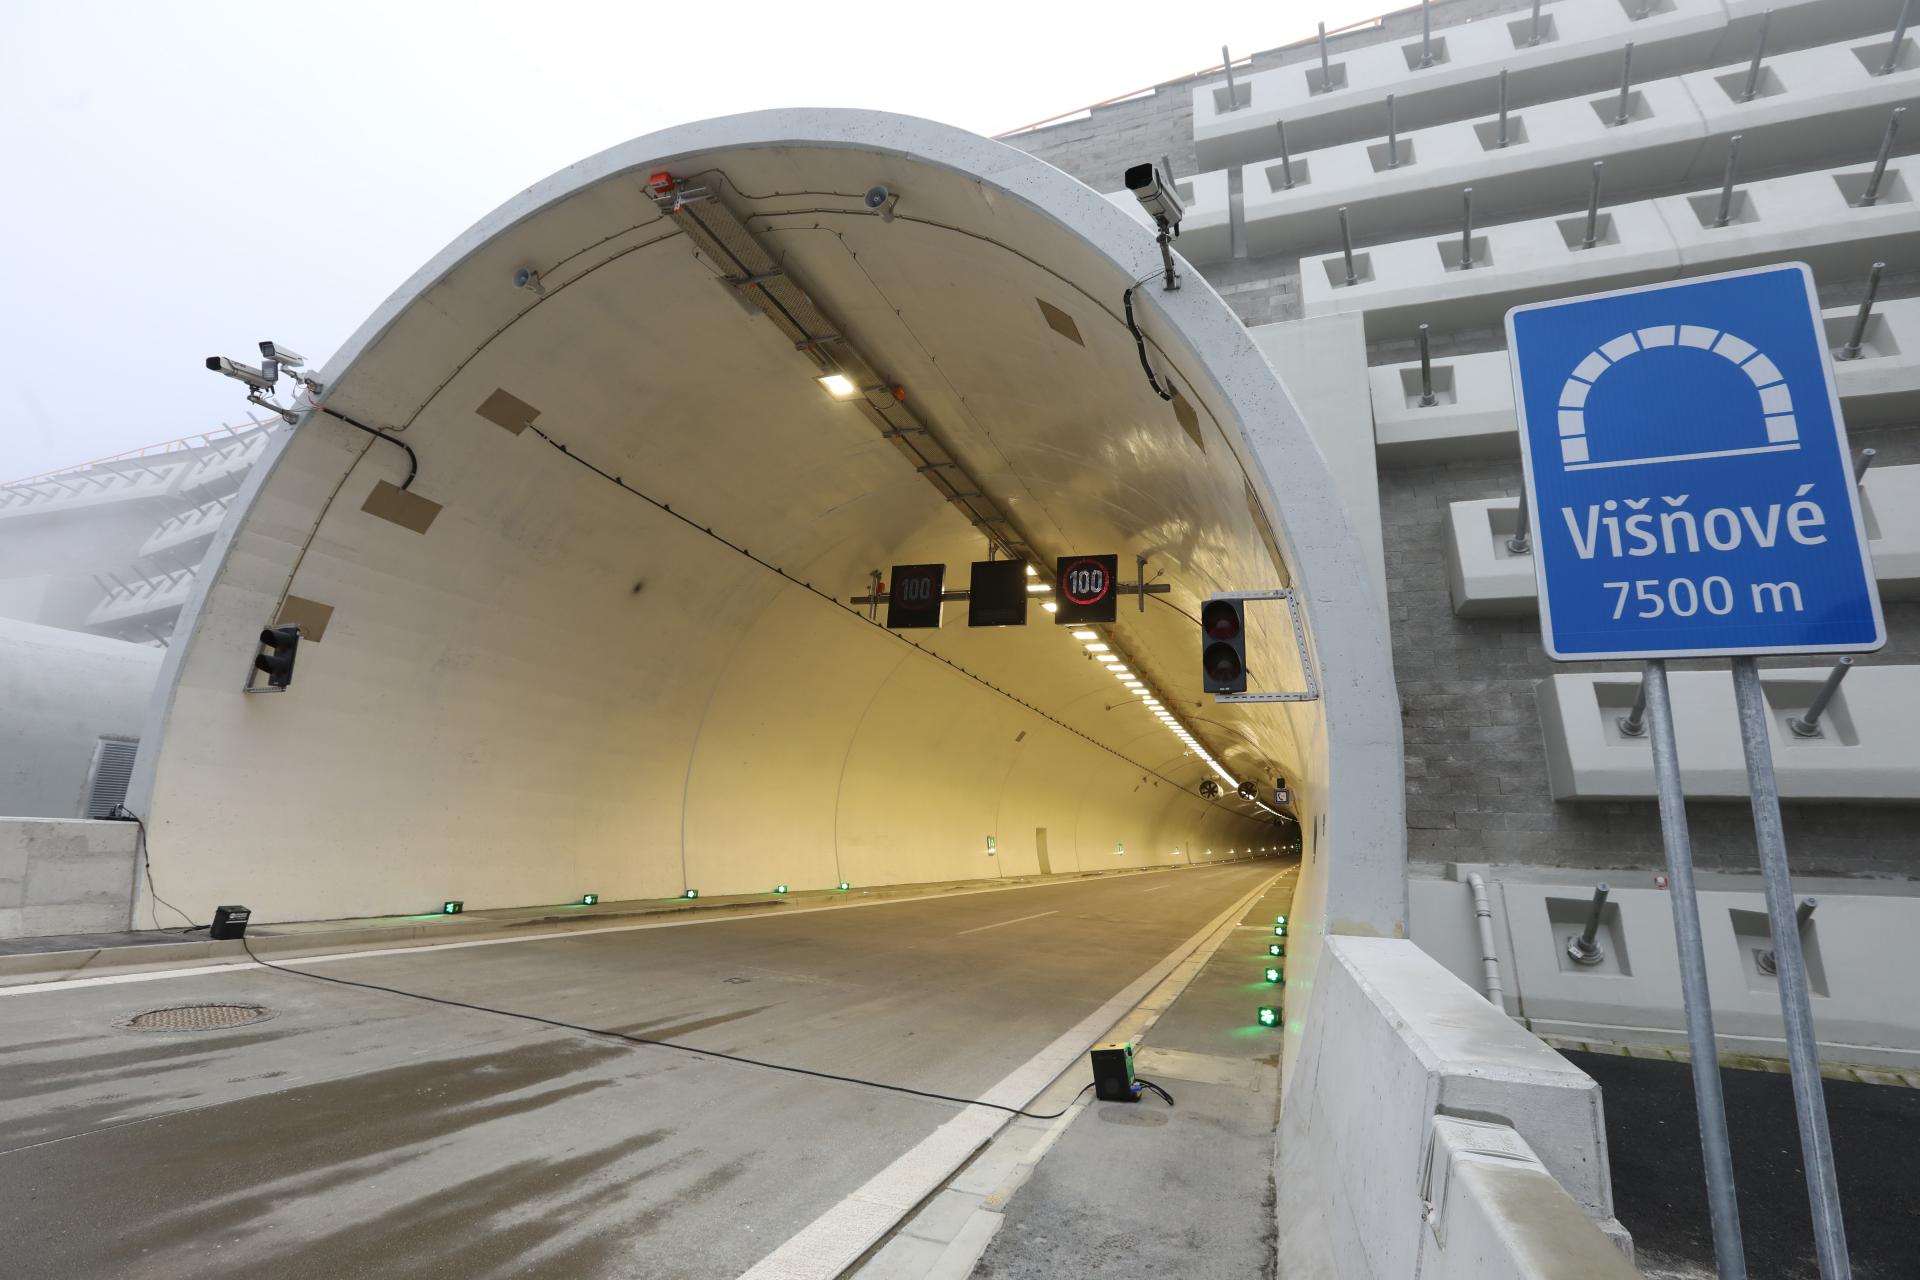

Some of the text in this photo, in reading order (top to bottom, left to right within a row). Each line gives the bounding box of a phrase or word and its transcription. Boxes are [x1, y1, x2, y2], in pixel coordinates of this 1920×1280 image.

[1562, 483, 1827, 559] Višňové
[902, 577, 931, 600] 100
[1070, 569, 1103, 594] 100
[1603, 575, 1803, 619] 7500 m
